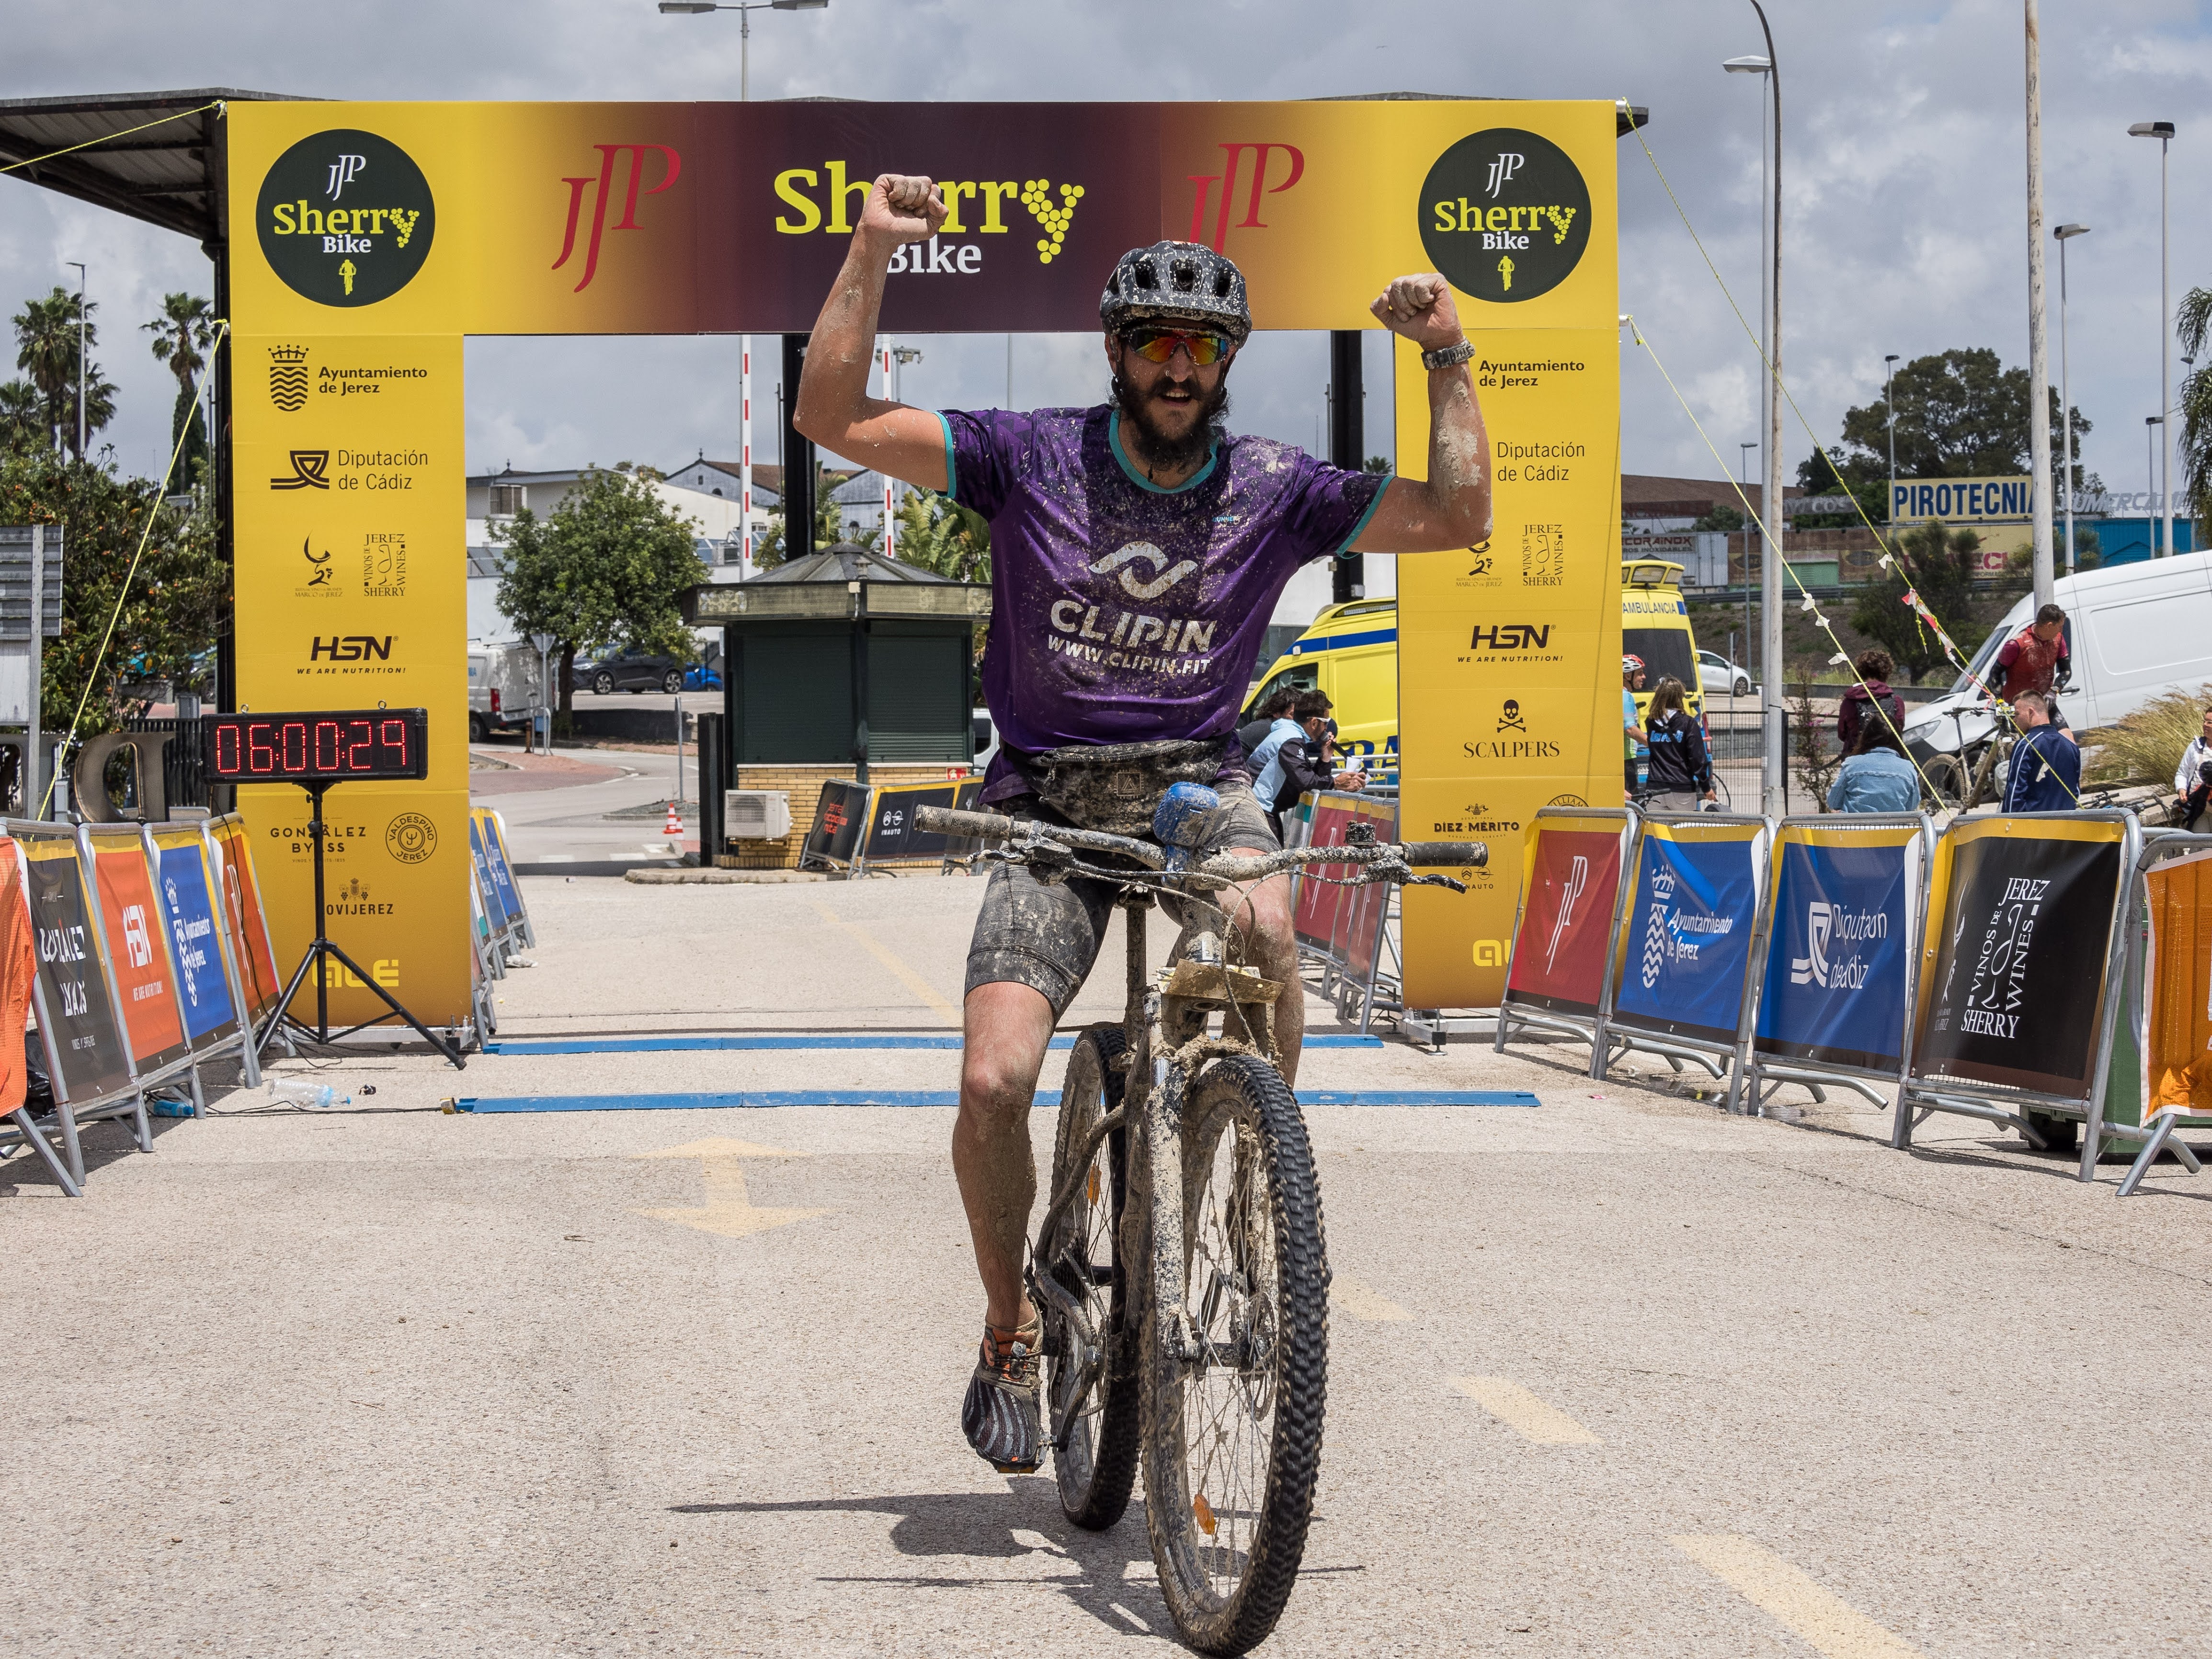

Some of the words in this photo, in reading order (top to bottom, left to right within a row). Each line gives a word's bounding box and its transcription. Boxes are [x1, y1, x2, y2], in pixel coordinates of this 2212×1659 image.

[774, 160, 1084, 264] Shrry
[273, 200, 420, 248] Sherry
[1435, 198, 1576, 245] Sherry
[323, 235, 371, 253] Bike
[1482, 231, 1529, 250] Bike
[319, 366, 427, 382] Ayuntamiento
[1479, 360, 1585, 374] Ayuntamiento
[319, 382, 337, 394] de
[341, 382, 380, 396] Jerez
[1479, 375, 1496, 386] de
[1500, 375, 1539, 389] Jerez
[338, 450, 428, 468] Diputación
[1497, 442, 1585, 460] Diputación
[338, 474, 358, 490] de
[366, 474, 412, 490] Cádiz
[1497, 466, 1516, 481] de
[1525, 465, 1569, 481] Cádiz
[1895, 482, 2032, 517] PIROTECNI
[1522, 524, 1562, 536] JEREZ
[364, 534, 405, 546] JEREZ
[1522, 545, 1532, 570] VINOS
[1555, 540, 1563, 576] WINES
[364, 556, 373, 580] VINOS
[397, 550, 406, 586] WINES
[1523, 577, 1563, 586] SHERRY
[364, 587, 406, 596] SHERRY
[1622, 602, 1676, 614] AMBULANCIA
[1051, 600, 1217, 653] CLIPIN
[1048, 635, 1210, 674] WWW.CLIPIN.FIT
[217, 720, 406, 773] 06:00:29
[1464, 741, 1560, 758] SCALPERS
[270, 824, 366, 838] GONÁLEZ
[389, 816, 434, 841] VALDESPINO
[292, 842, 345, 853] BYSS
[396, 849, 428, 861] JEREZ
[1998, 877, 2052, 906] JEREZ
[326, 904, 394, 915] OVIJEREZ
[1667, 908, 1732, 935] Ayuntamiento
[1667, 934, 1675, 957] de
[1676, 936, 1699, 963] Jerez
[1971, 929, 1996, 992] VINOS
[1990, 909, 2002, 925] DE
[2005, 919, 2034, 1012] WINES
[1961, 1009, 2020, 1039] SHERRY
